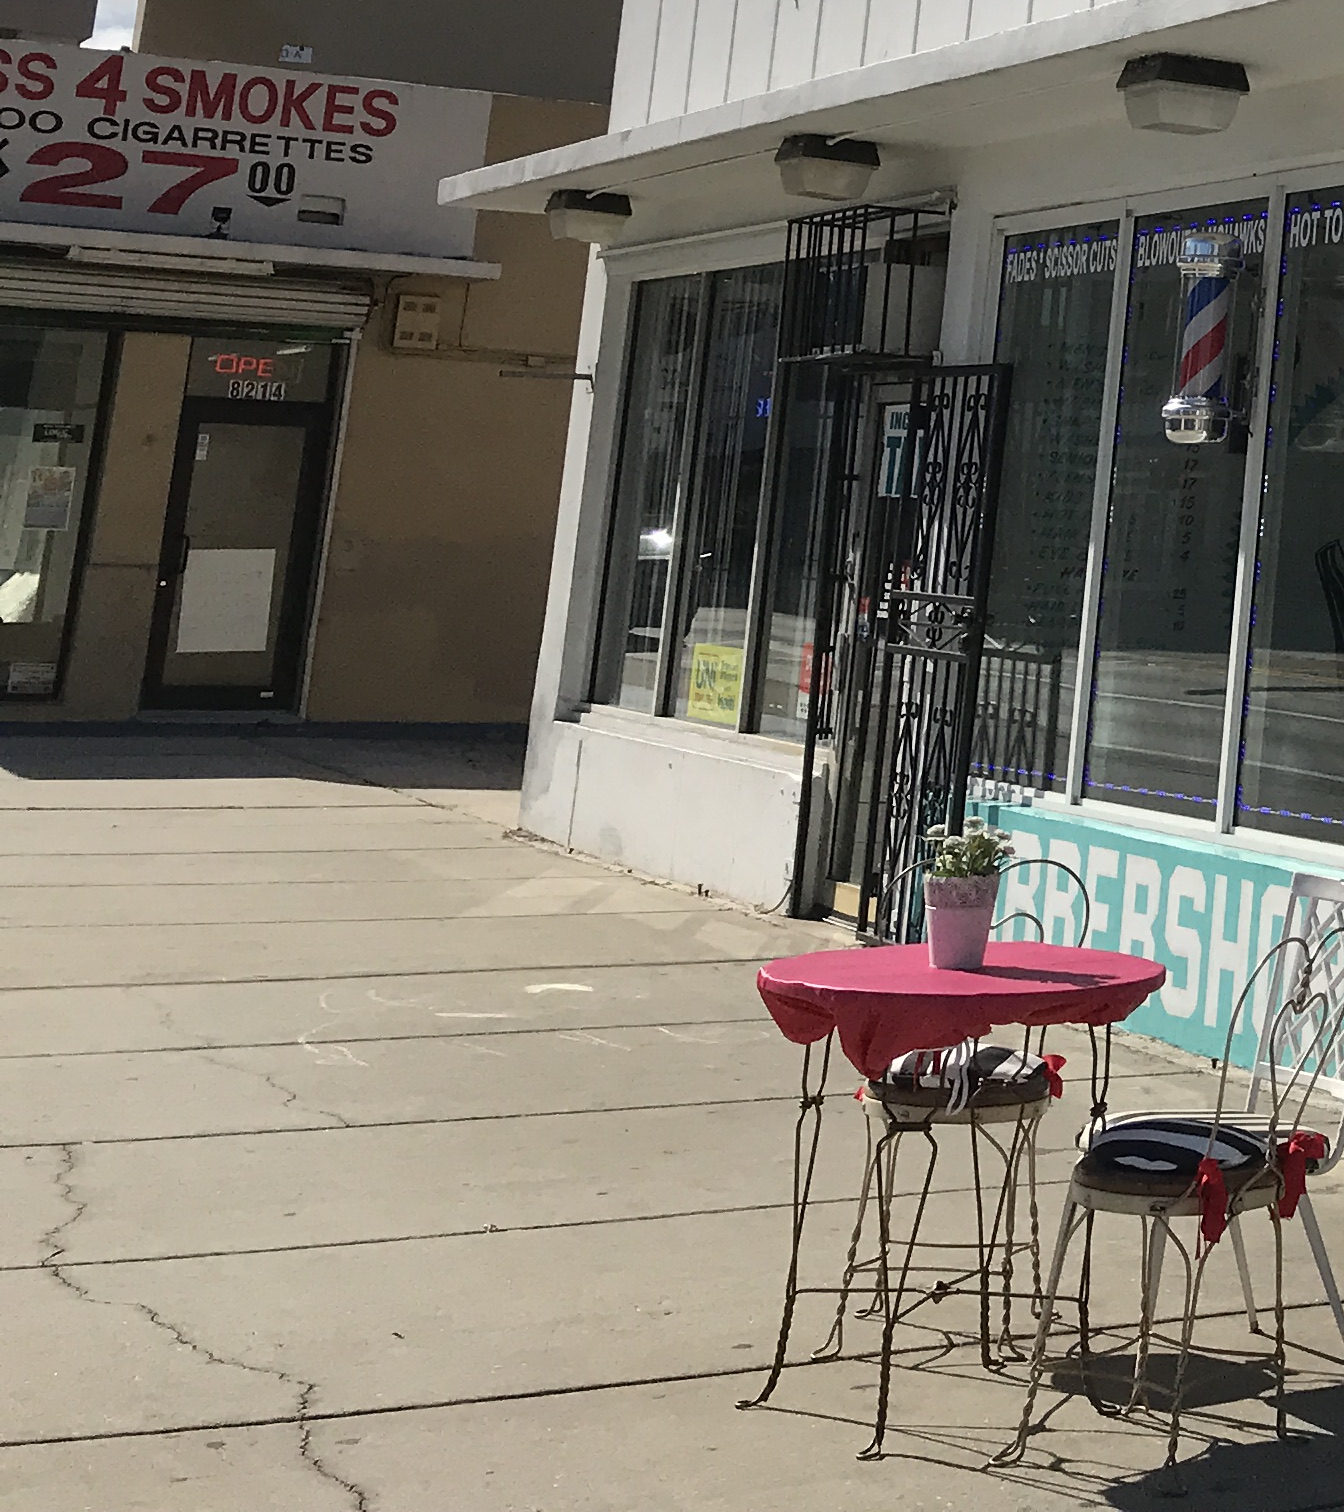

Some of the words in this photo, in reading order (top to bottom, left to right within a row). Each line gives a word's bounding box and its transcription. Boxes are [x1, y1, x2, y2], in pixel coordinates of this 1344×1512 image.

[75, 54, 127, 117] 4
[142, 65, 400, 138] SMOKES
[87, 116, 374, 164] CIGARRETTES
[20, 141, 240, 215] 27
[1288, 208, 1320, 248] HOT
[1006, 250, 1037, 284] FADES
[1045, 243, 1087, 279] SCISSOR
[1089, 239, 1116, 273] CUTS
[229, 380, 284, 400] 8214
